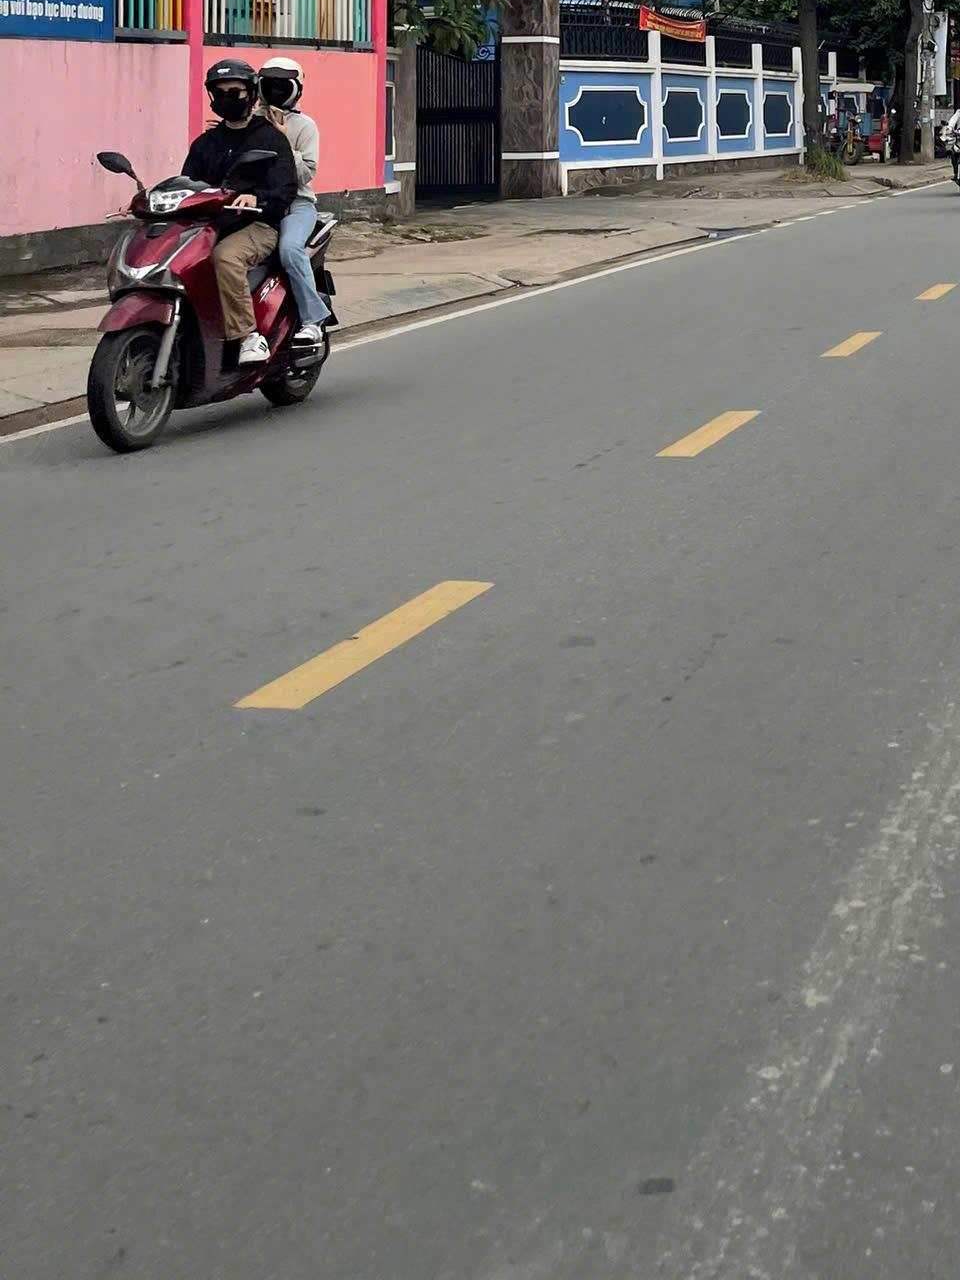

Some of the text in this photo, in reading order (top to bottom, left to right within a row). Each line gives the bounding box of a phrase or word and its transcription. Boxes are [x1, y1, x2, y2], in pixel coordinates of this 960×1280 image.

[45, 0, 59, 20] lực
[60, 1, 76, 22] học
[77, 3, 104, 22] đường
